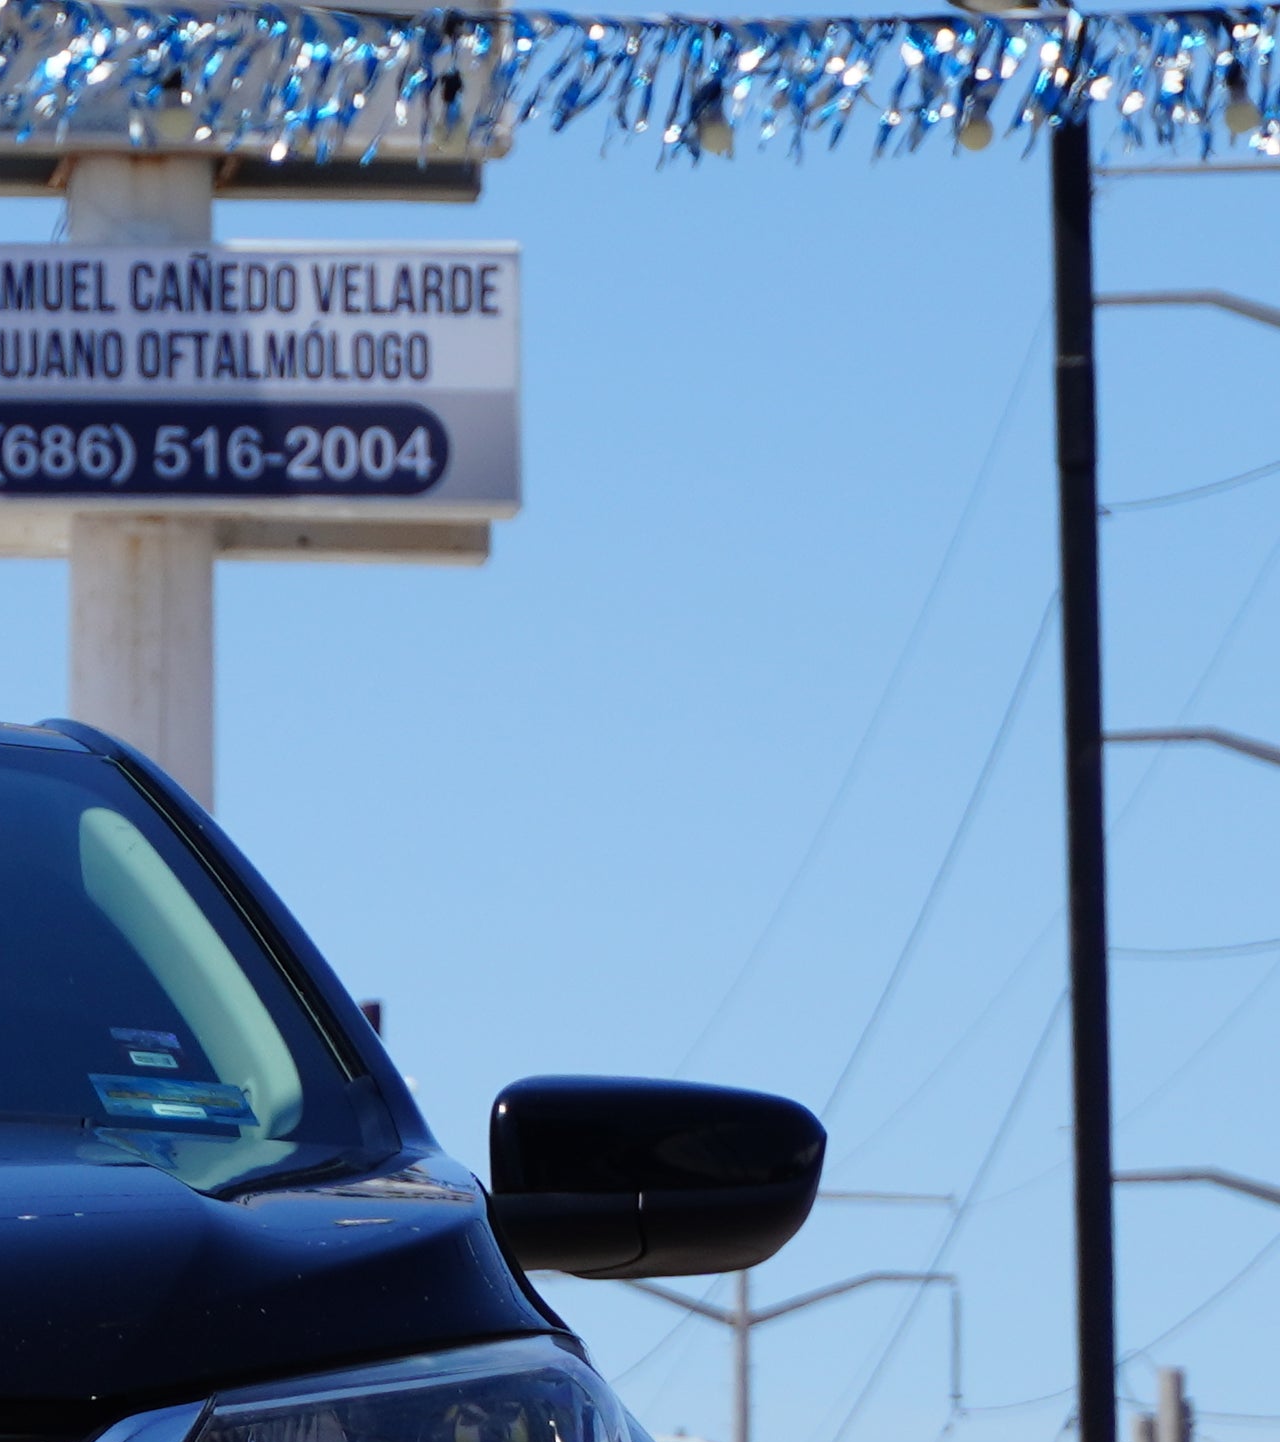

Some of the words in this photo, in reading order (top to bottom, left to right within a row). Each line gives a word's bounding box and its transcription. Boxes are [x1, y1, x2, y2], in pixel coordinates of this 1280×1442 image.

[128, 253, 300, 315] CAÑEDO
[309, 263, 502, 316] VELARDE
[139, 322, 432, 382] OFTALMÓLOGO
[151, 425, 436, 481] 516-2004
